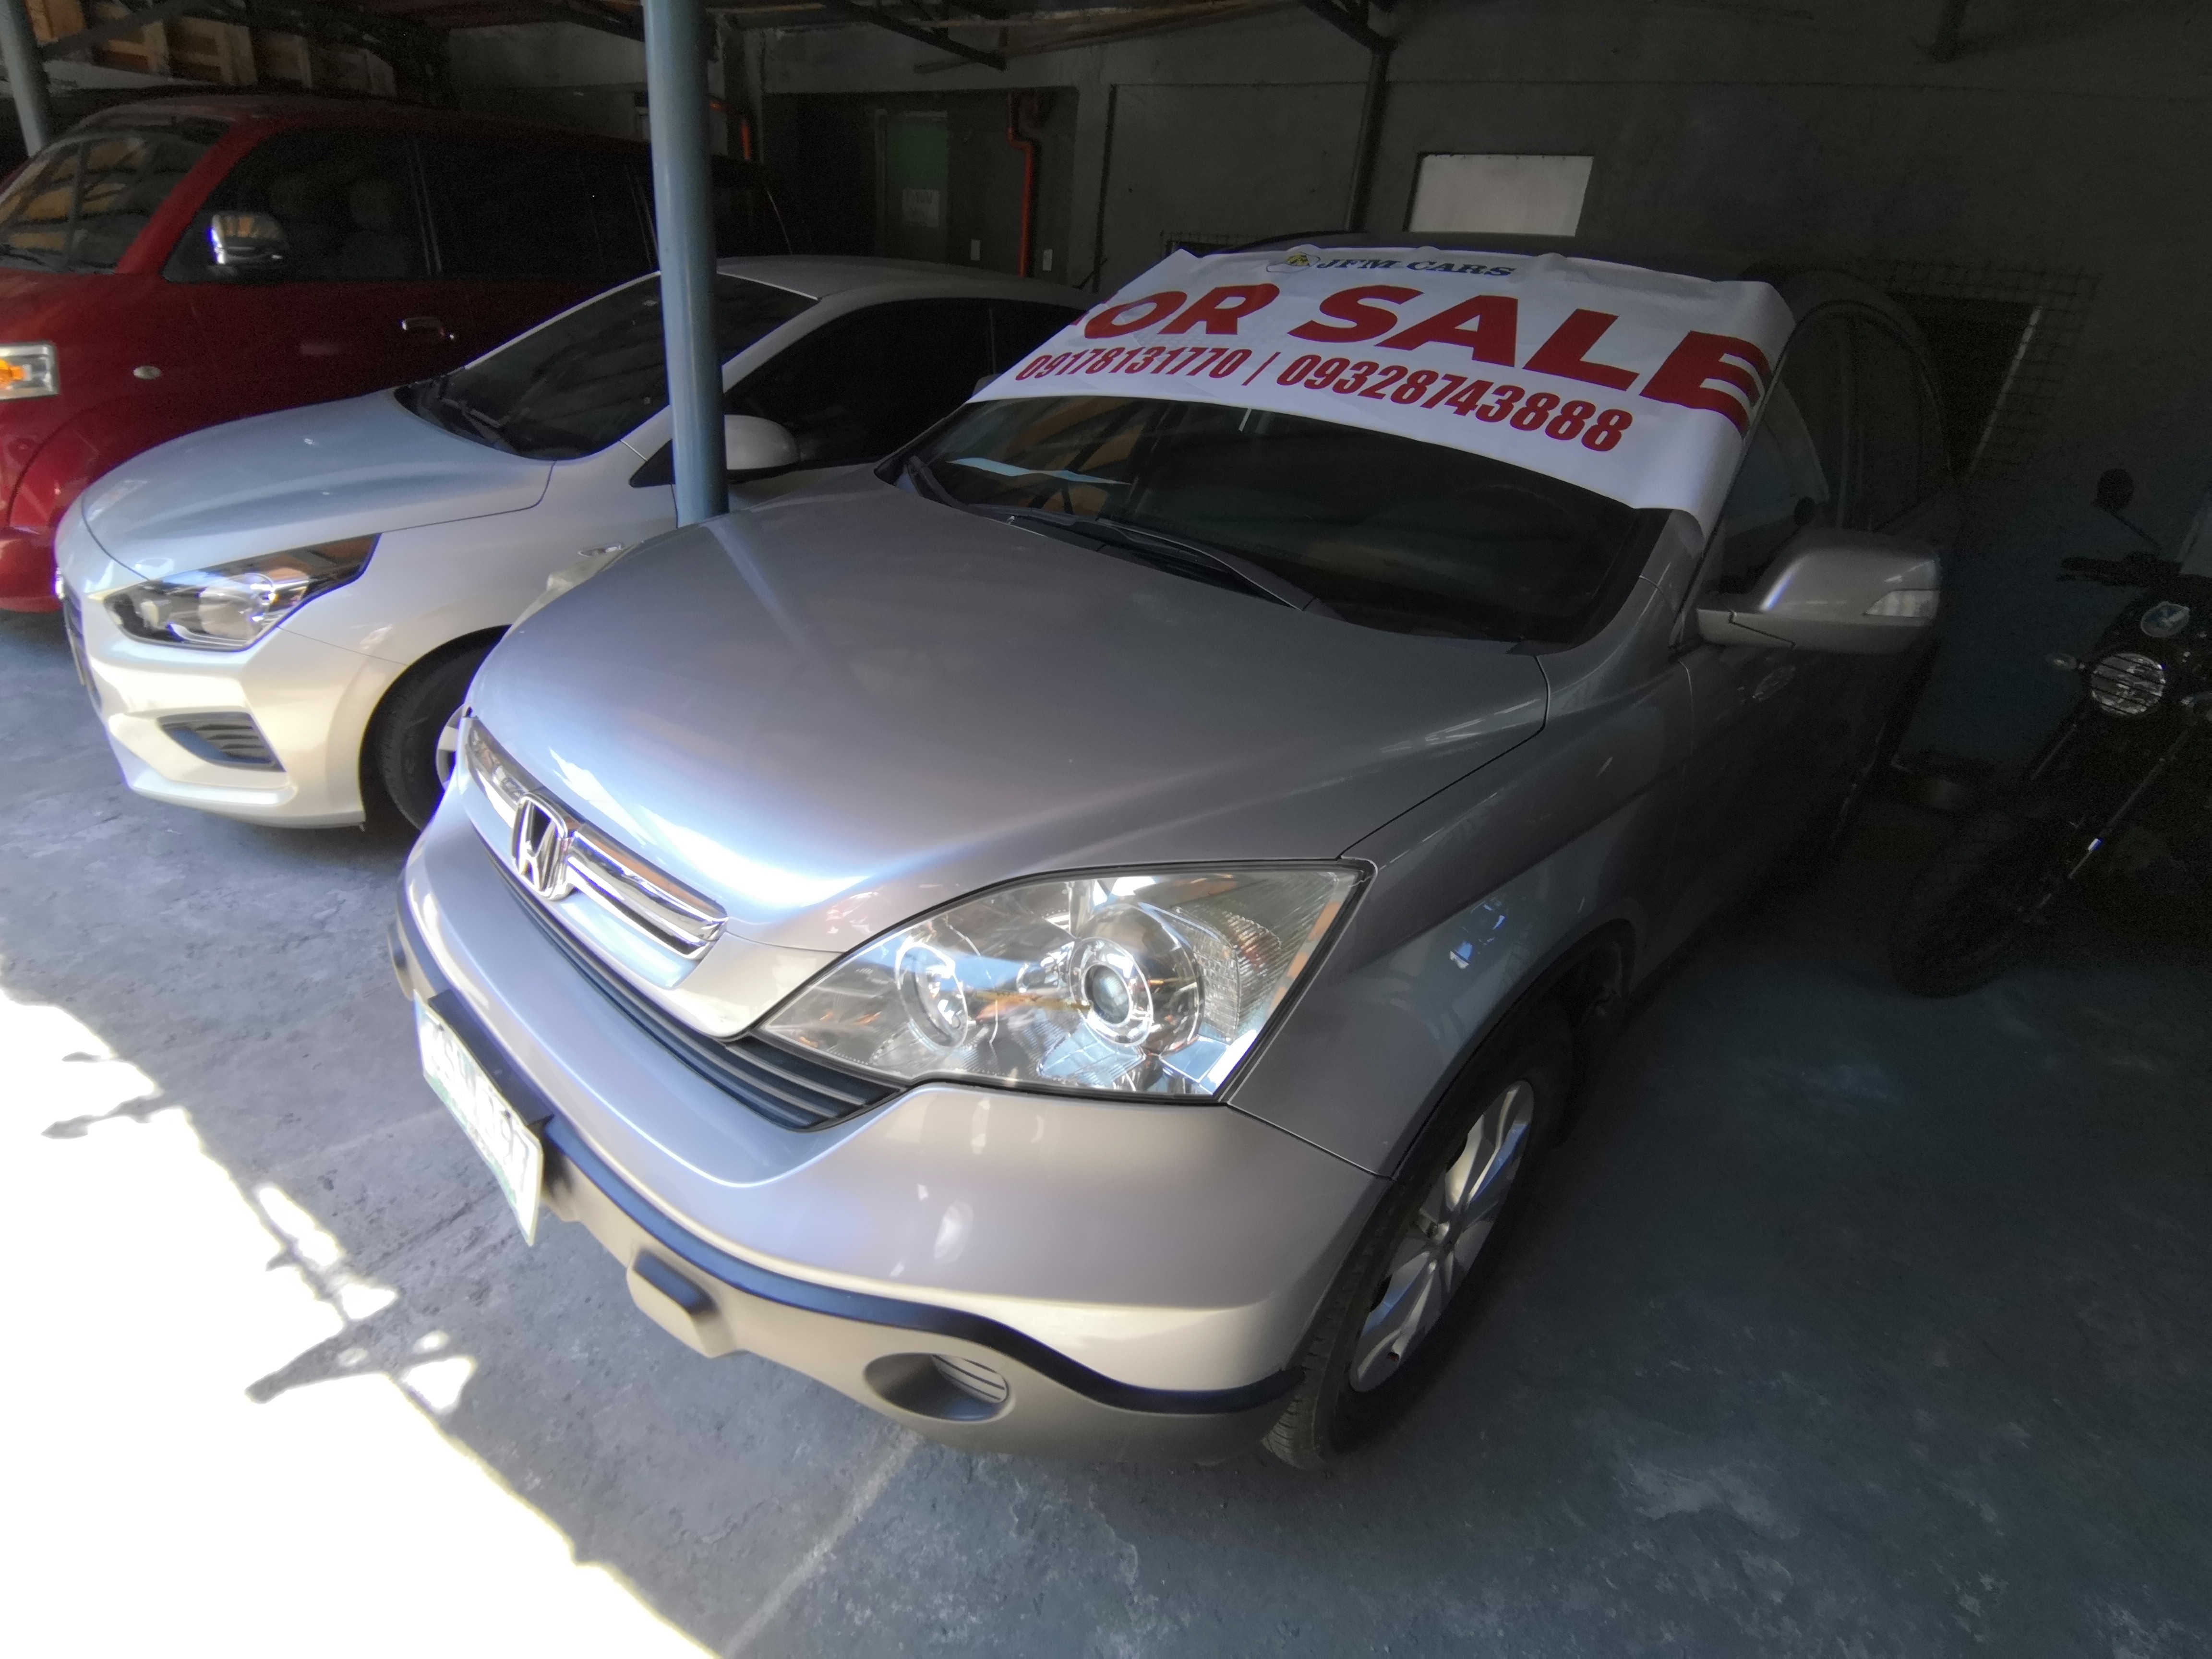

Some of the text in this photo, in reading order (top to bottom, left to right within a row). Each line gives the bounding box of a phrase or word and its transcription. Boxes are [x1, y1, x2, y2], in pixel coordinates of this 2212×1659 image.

[1316, 257, 1517, 276] JFM CARS
[1015, 346, 1252, 381] 09178131770
[1276, 354, 1632, 452] 09328743888
[1070, 282, 1772, 439] OR SALE
